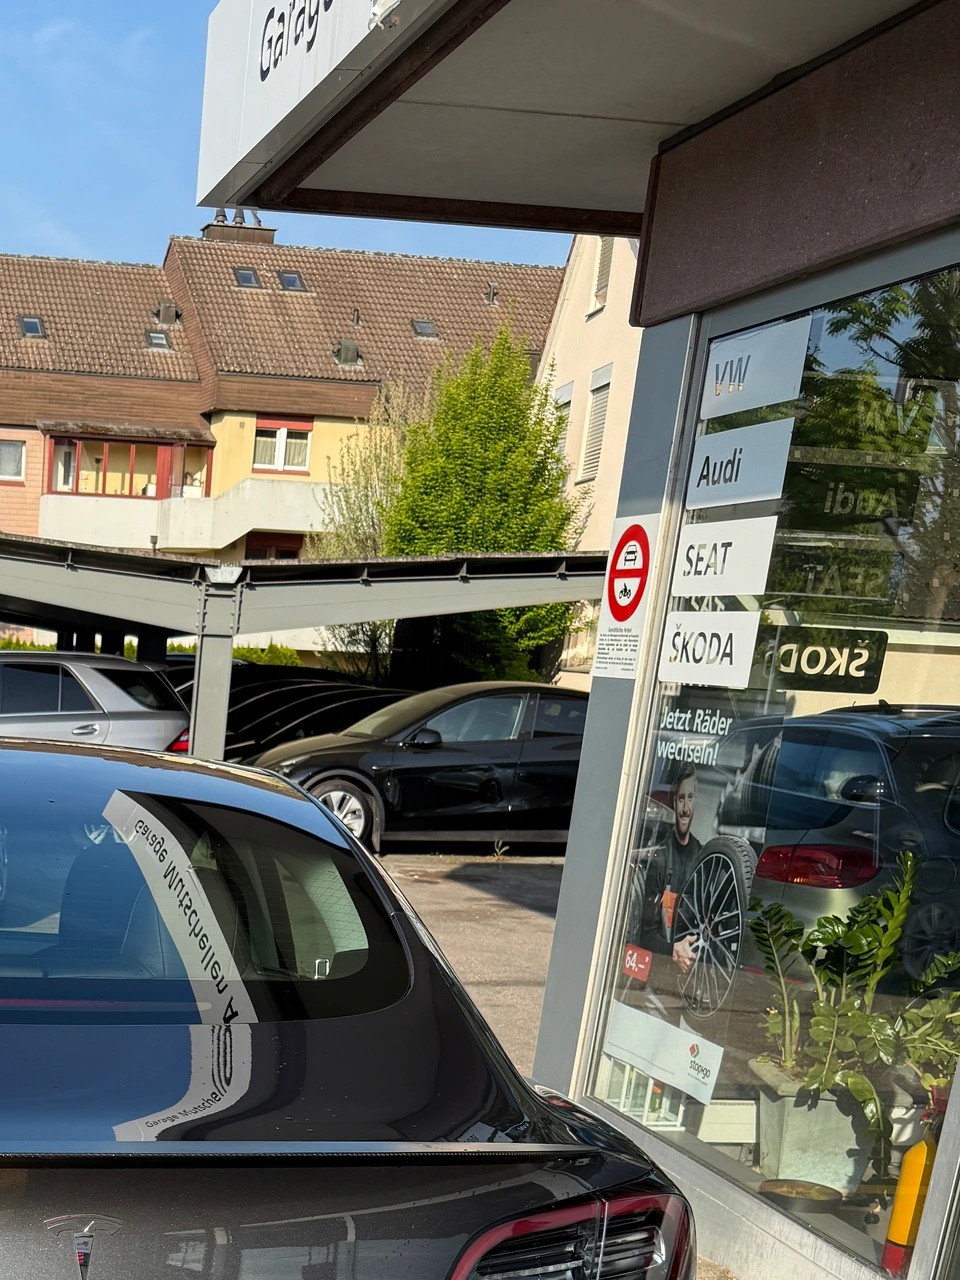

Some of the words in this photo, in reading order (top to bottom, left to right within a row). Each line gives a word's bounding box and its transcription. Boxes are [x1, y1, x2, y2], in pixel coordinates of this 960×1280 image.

[715, 354, 751, 396] VW
[696, 447, 743, 488] Audi
[683, 541, 733, 577] SEAT
[669, 623, 734, 666] ŠKODA
[660, 706, 692, 731] Jetzt
[693, 709, 733, 736] Räder
[657, 737, 719, 766] wechseln!
